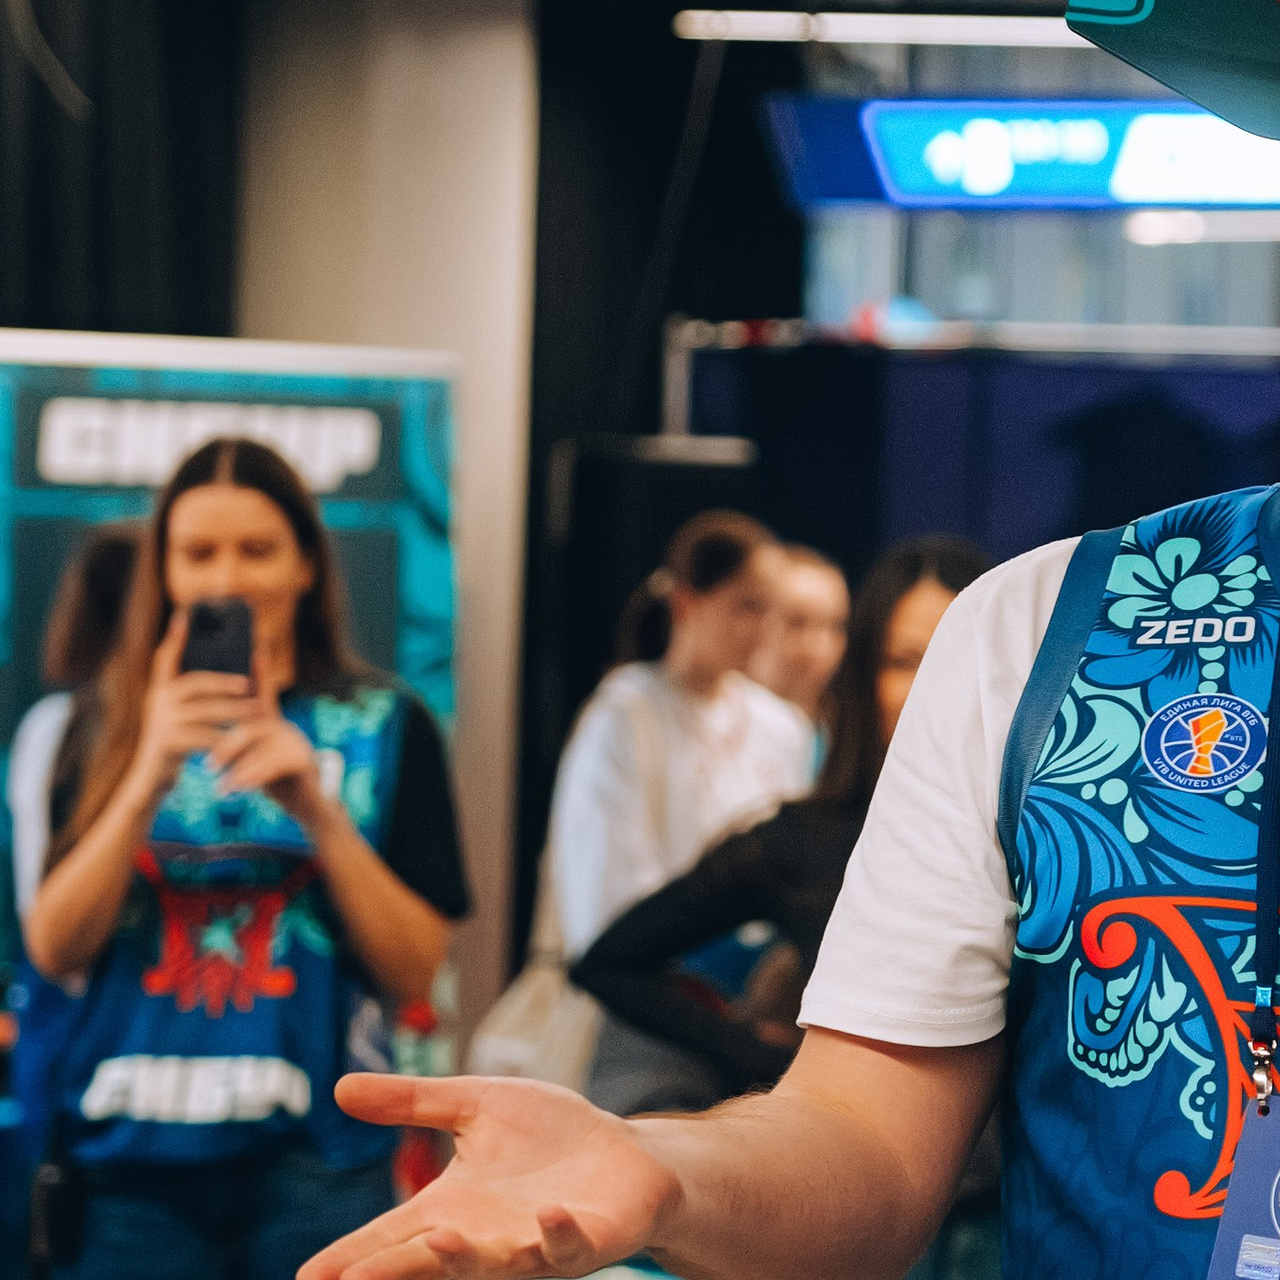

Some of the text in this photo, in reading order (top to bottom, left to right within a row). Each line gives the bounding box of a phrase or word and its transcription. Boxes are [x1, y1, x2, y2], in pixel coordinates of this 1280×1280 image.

[1136, 616, 1256, 645] ZEDO
[1160, 698, 1259, 727] ЕДИНАЯ ЛИГА ВТБ
[1153, 757, 1251, 788] VTB UNITED LEAGUE
